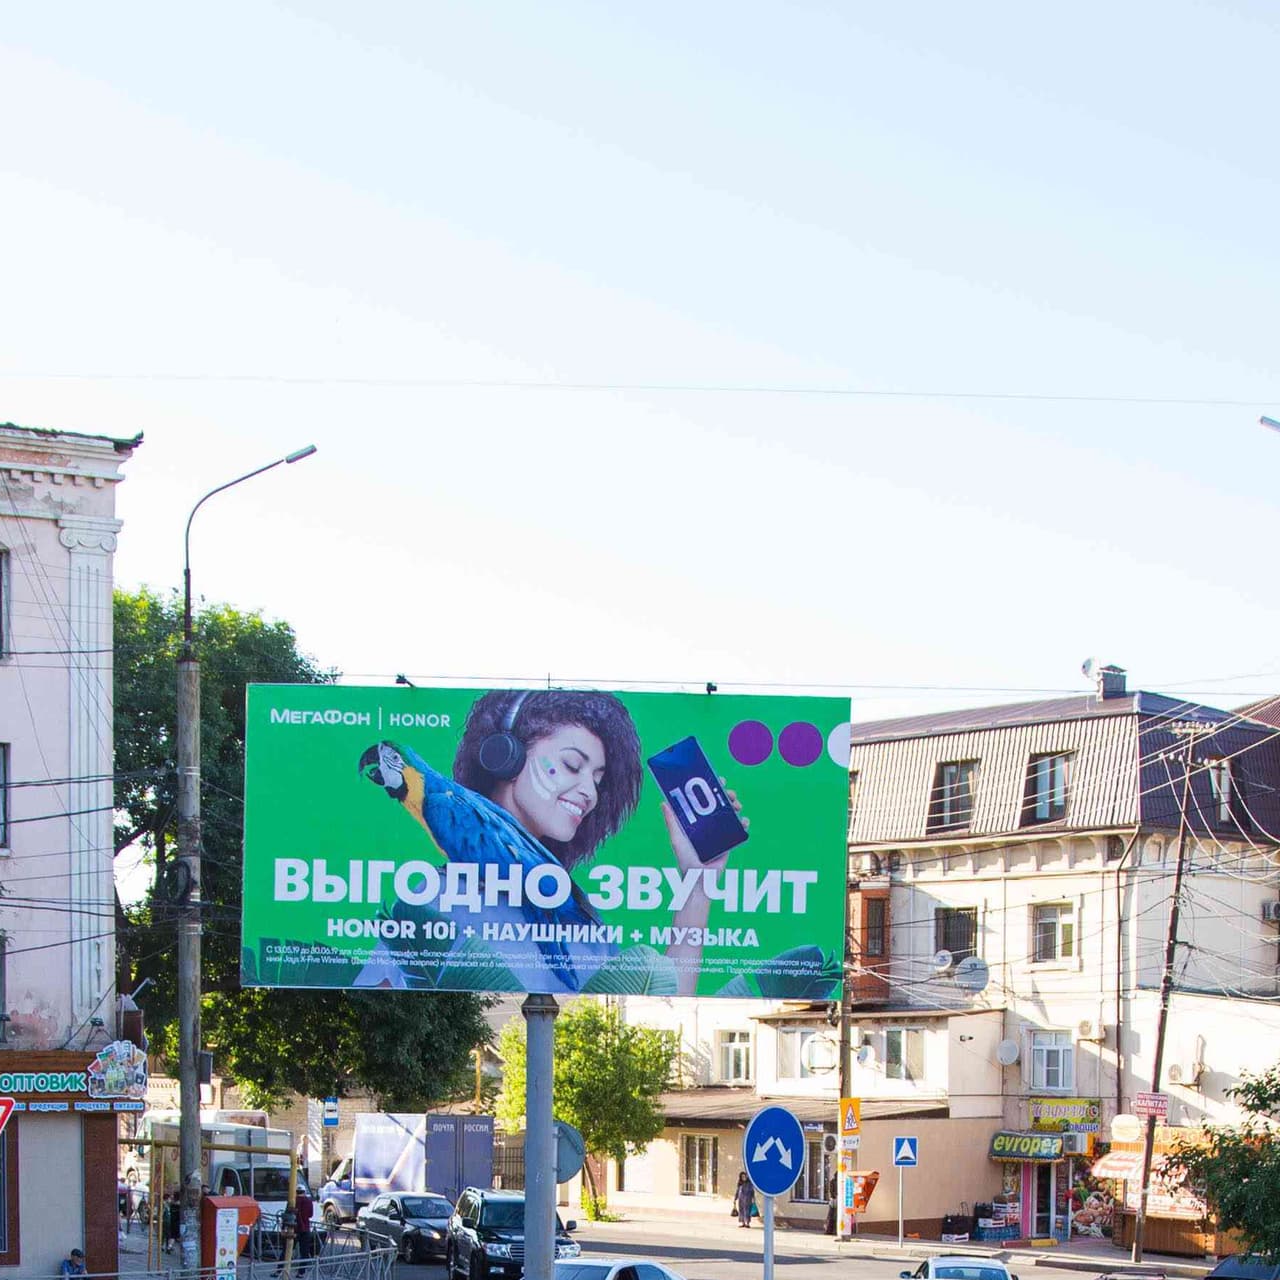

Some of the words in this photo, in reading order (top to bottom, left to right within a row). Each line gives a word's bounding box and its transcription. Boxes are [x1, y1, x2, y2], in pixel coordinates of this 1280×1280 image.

[389, 713, 451, 728] HONOR
[669, 777, 726, 824] 10i
[274, 858, 572, 913] ВЫГОДНО
[588, 864, 818, 914] ЗВУЧИТ
[327, 918, 416, 940] HONOR
[423, 921, 456, 940] 10i
[482, 922, 624, 944] НАУШНИКИ
[650, 926, 760, 948] МУЗЫКА
